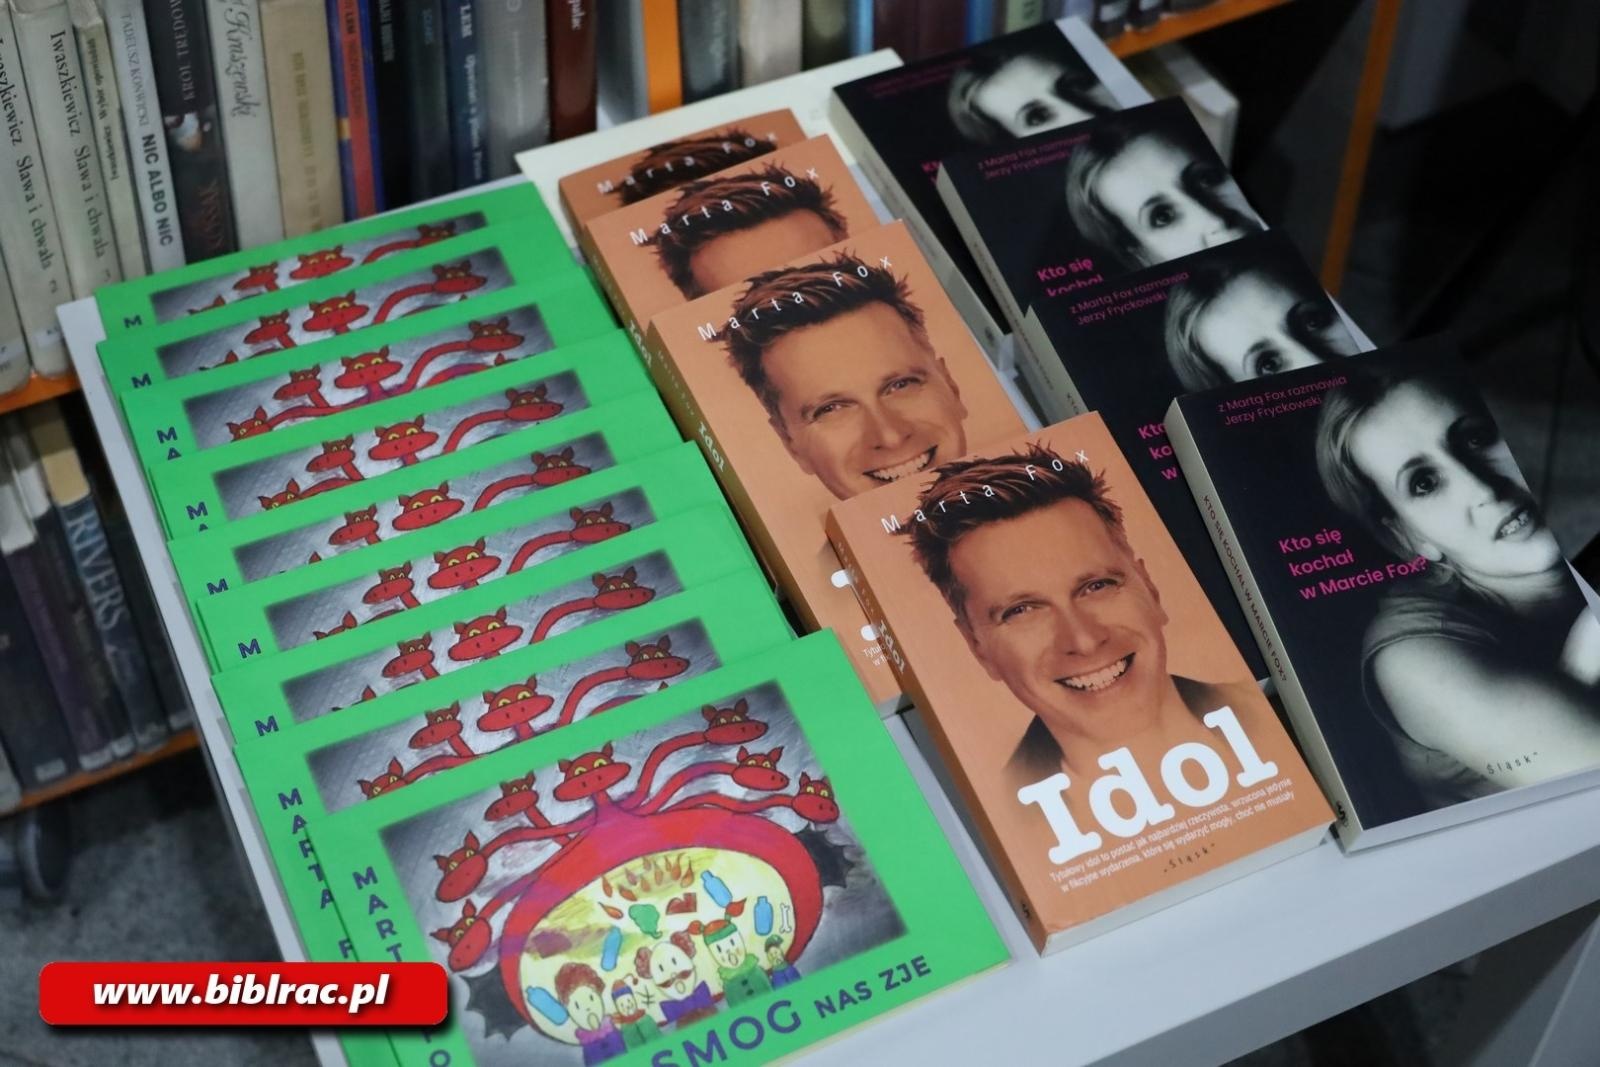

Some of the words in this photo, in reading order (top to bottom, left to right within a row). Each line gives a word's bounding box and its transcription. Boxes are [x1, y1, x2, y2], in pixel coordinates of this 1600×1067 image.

[119, 14, 140, 66] TADEUSZ
[459, 4, 473, 38] LEM
[50, 30, 83, 137] Iwaszkiewicz
[224, 8, 260, 118] Kraszewski
[0, 38, 22, 146] szkiewicz
[74, 144, 93, 192] Sława
[141, 134, 160, 164] NIC
[597, 155, 695, 194] Marta
[722, 132, 777, 154] Fox
[17, 155, 36, 203] Sława
[85, 193, 99, 203] i
[148, 170, 167, 213] ALBO
[28, 203, 43, 214] i
[630, 199, 733, 247] Marta
[760, 167, 819, 197] Fox
[31, 218, 54, 270] chwała
[87, 207, 109, 258] chwała
[156, 217, 173, 246] NIC
[1036, 264, 1067, 283] Kto
[1070, 258, 1094, 274] się
[1112, 288, 1133, 301] Fox
[1134, 271, 1190, 294] rozmawia
[698, 291, 804, 342] Marta
[832, 256, 892, 288] Fox
[1078, 310, 1107, 326] Jerzy
[1106, 290, 1168, 316] Fryckowski
[1217, 403, 1226, 413] z
[1226, 393, 1264, 412] Martą
[1264, 388, 1287, 403] Fox
[1287, 374, 1348, 397] rozmawia
[1223, 409, 1256, 427] Jerzy
[1256, 396, 1322, 420] Fryckowski
[698, 421, 725, 473] Idol
[881, 484, 995, 535] Marta
[1025, 449, 1090, 481] Fox
[1160, 466, 1177, 481] w
[1278, 536, 1313, 555] Kto
[1314, 528, 1343, 548] się
[1288, 549, 1355, 578] kochał
[67, 510, 126, 630] RIVERS
[1299, 585, 1318, 601] w
[1318, 571, 1385, 596] Marcie
[1387, 555, 1429, 579] Fox?
[879, 619, 905, 674] Idol
[1250, 603, 1273, 650] MARCIE
[1270, 650, 1287, 682] FOX?
[1017, 706, 1279, 866] Idol
[813, 981, 874, 1018] NAS
[882, 955, 931, 991] ZJE
